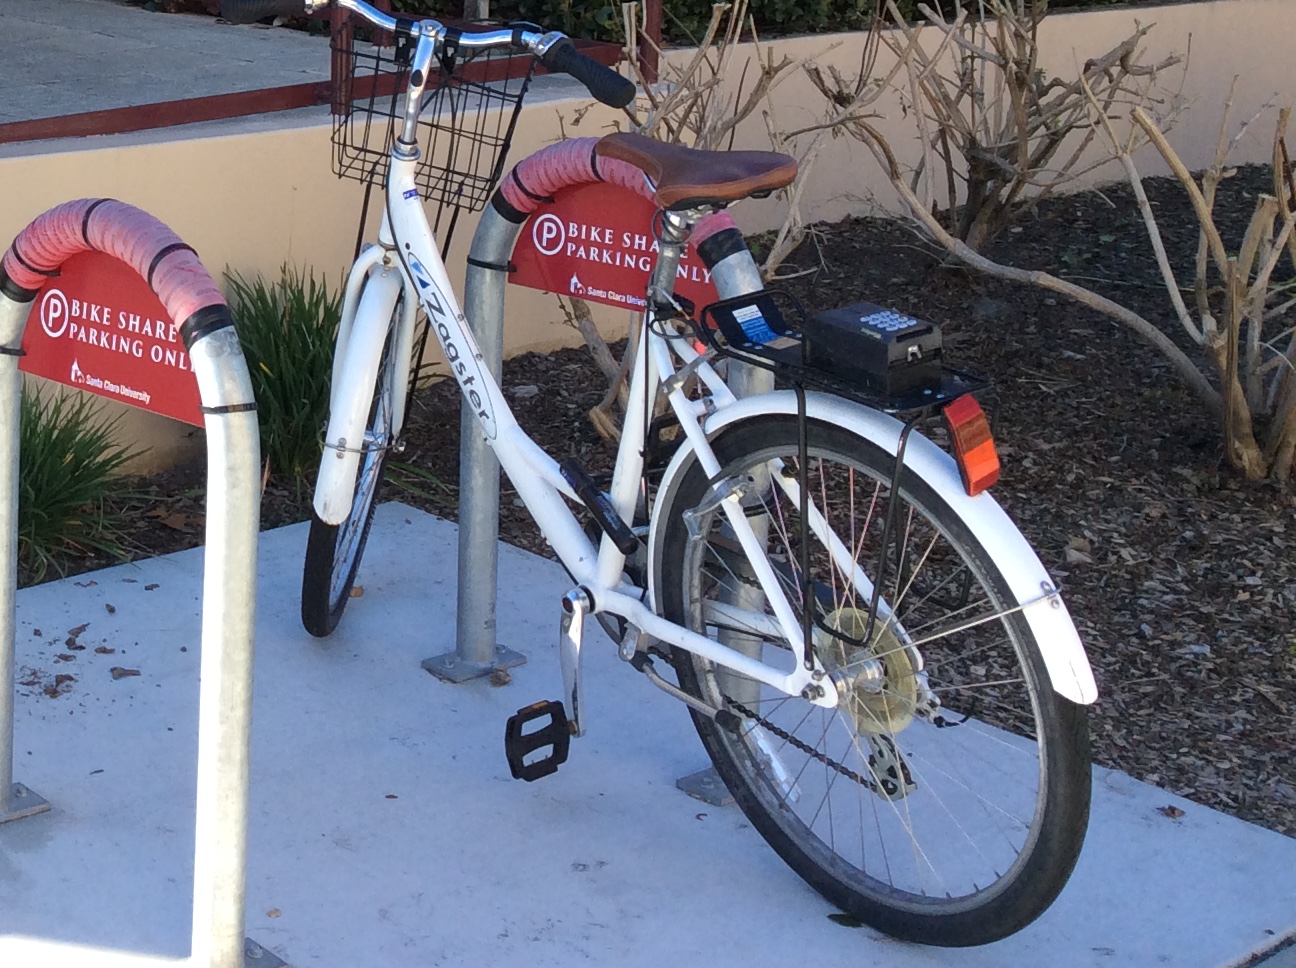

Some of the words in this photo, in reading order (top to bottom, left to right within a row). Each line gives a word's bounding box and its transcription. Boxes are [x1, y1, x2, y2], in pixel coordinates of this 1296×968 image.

[568, 222, 614, 245] BIKE
[622, 232, 688, 259] SHAE
[566, 242, 651, 272] PARKING
[676, 264, 712, 283] NLY
[69, 323, 143, 358] PARKING
[71, 299, 111, 326] BIKE
[118, 311, 177, 343] SHARE
[425, 292, 490, 421] Zagster
